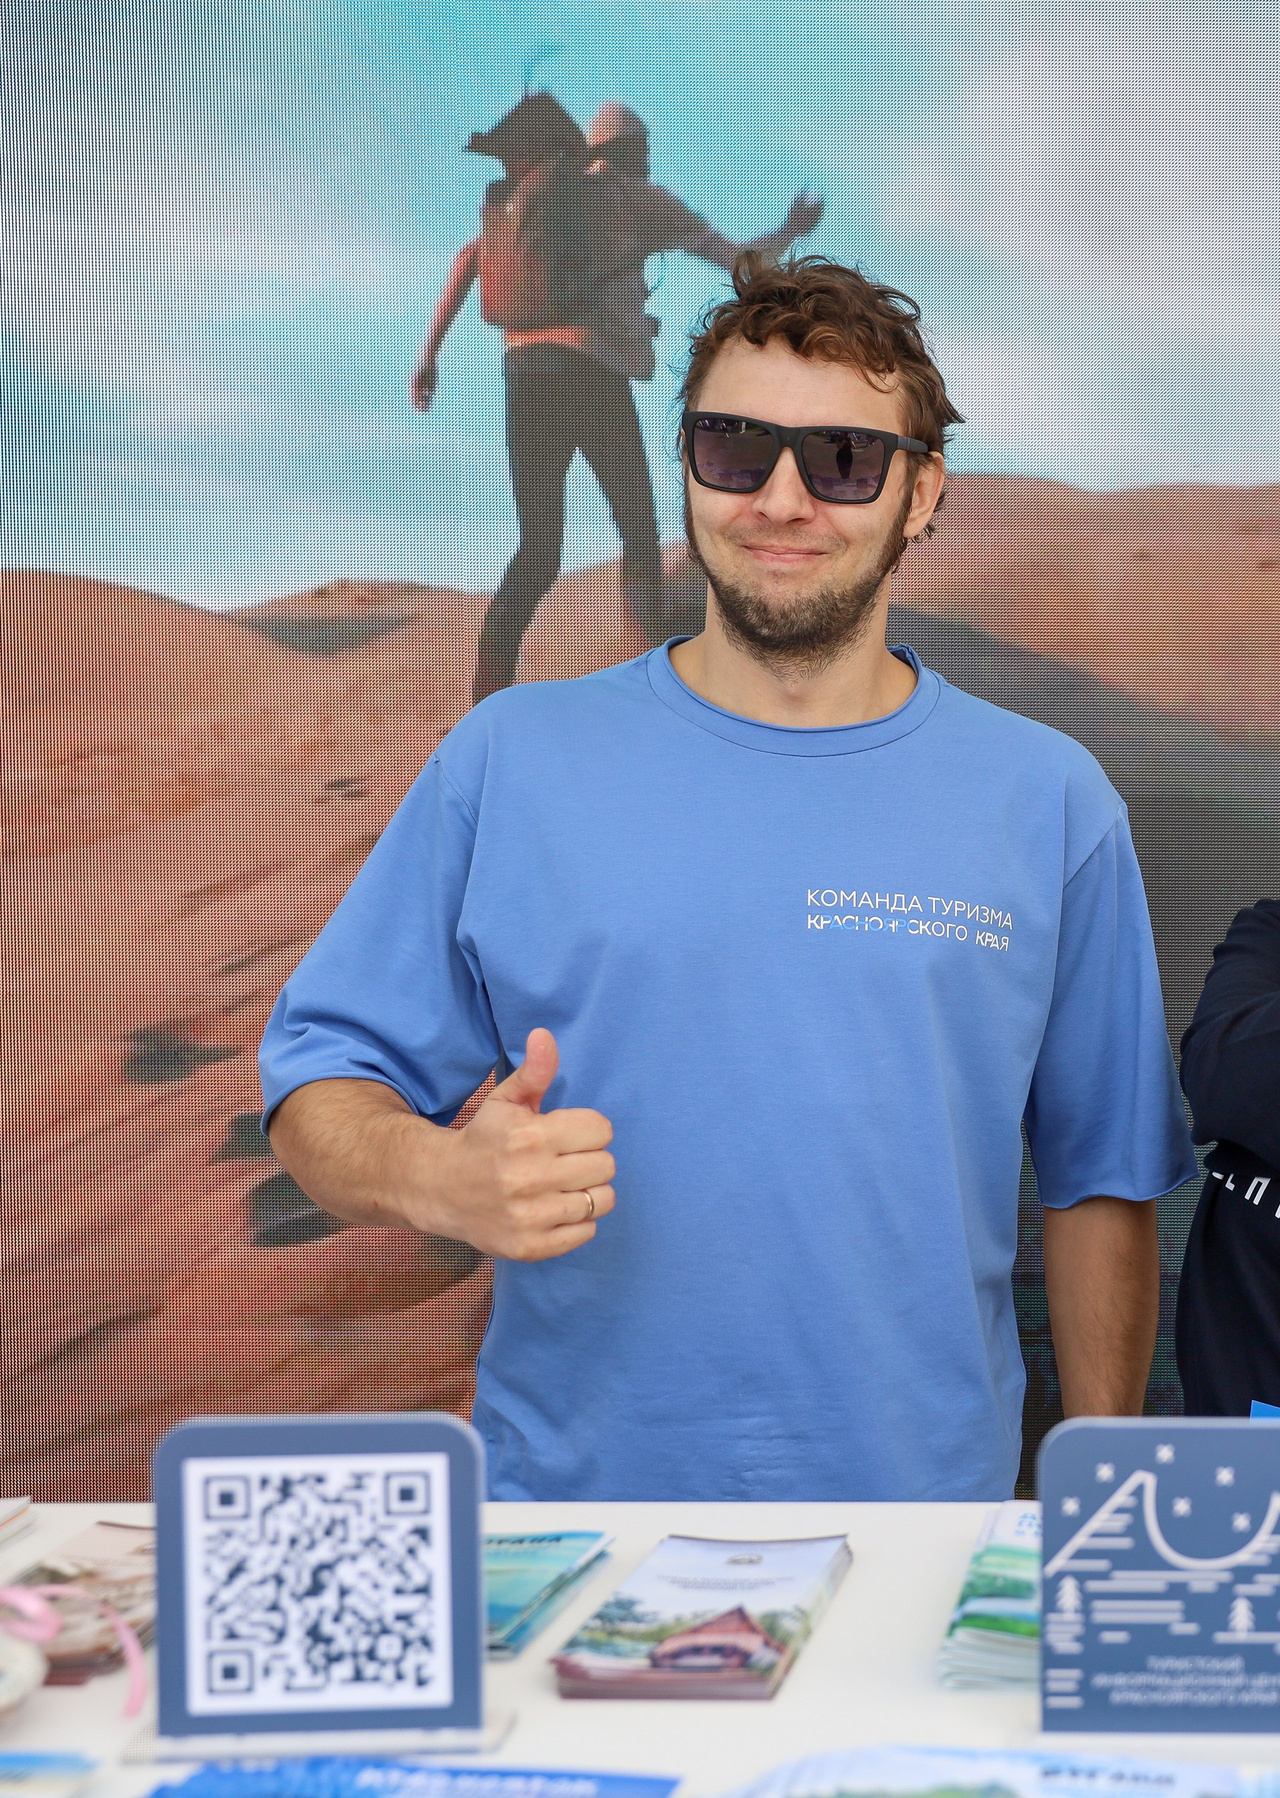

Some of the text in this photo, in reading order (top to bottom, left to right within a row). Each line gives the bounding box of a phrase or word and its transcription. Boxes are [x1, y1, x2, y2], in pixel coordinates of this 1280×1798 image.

[807, 888, 1014, 931] КОМАНДА ТУРИЗМА
[974, 930, 1010, 952] КРАЯ
